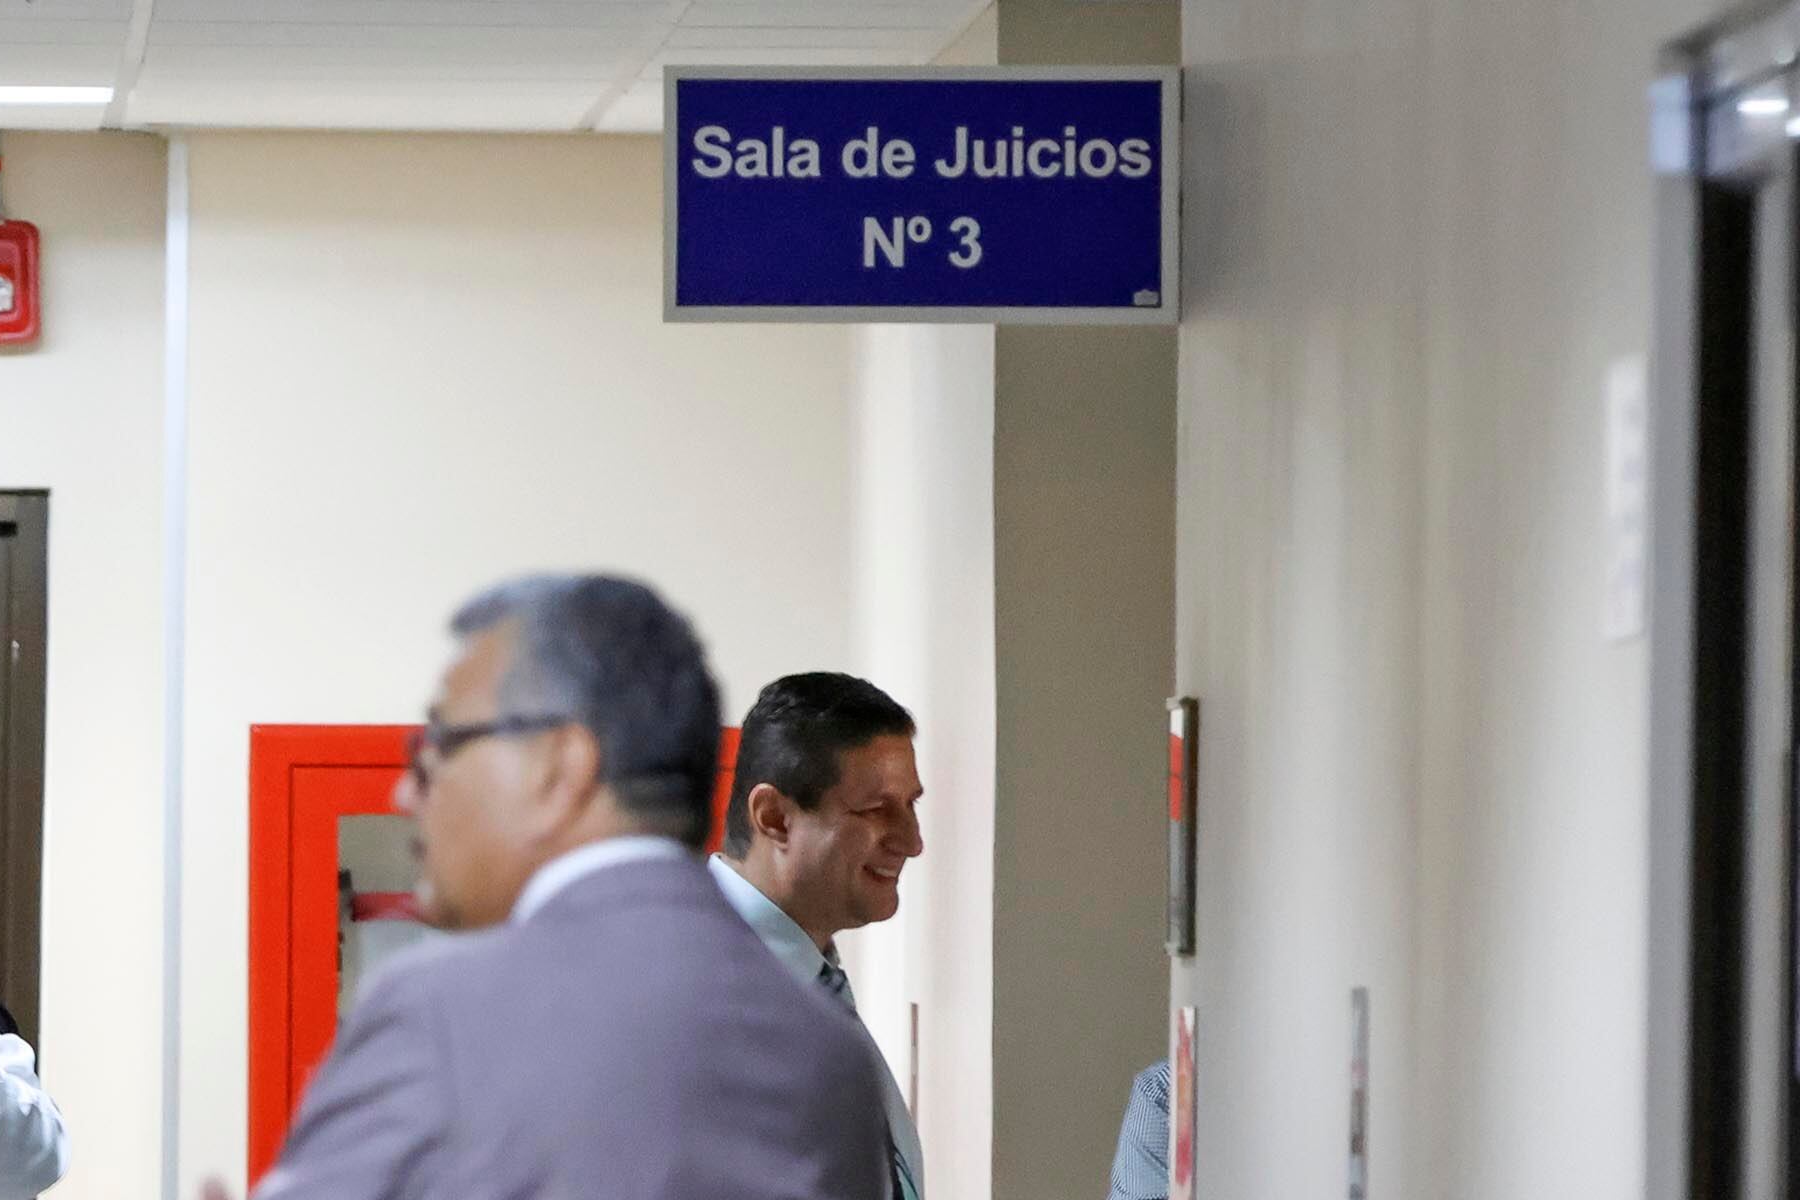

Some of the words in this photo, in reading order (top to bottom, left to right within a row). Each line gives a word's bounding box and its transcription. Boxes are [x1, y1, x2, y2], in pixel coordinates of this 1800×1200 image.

[691, 124, 822, 179] Sala
[840, 125, 917, 179] de
[933, 125, 1153, 179] Juicios
[947, 215, 983, 269] 3
